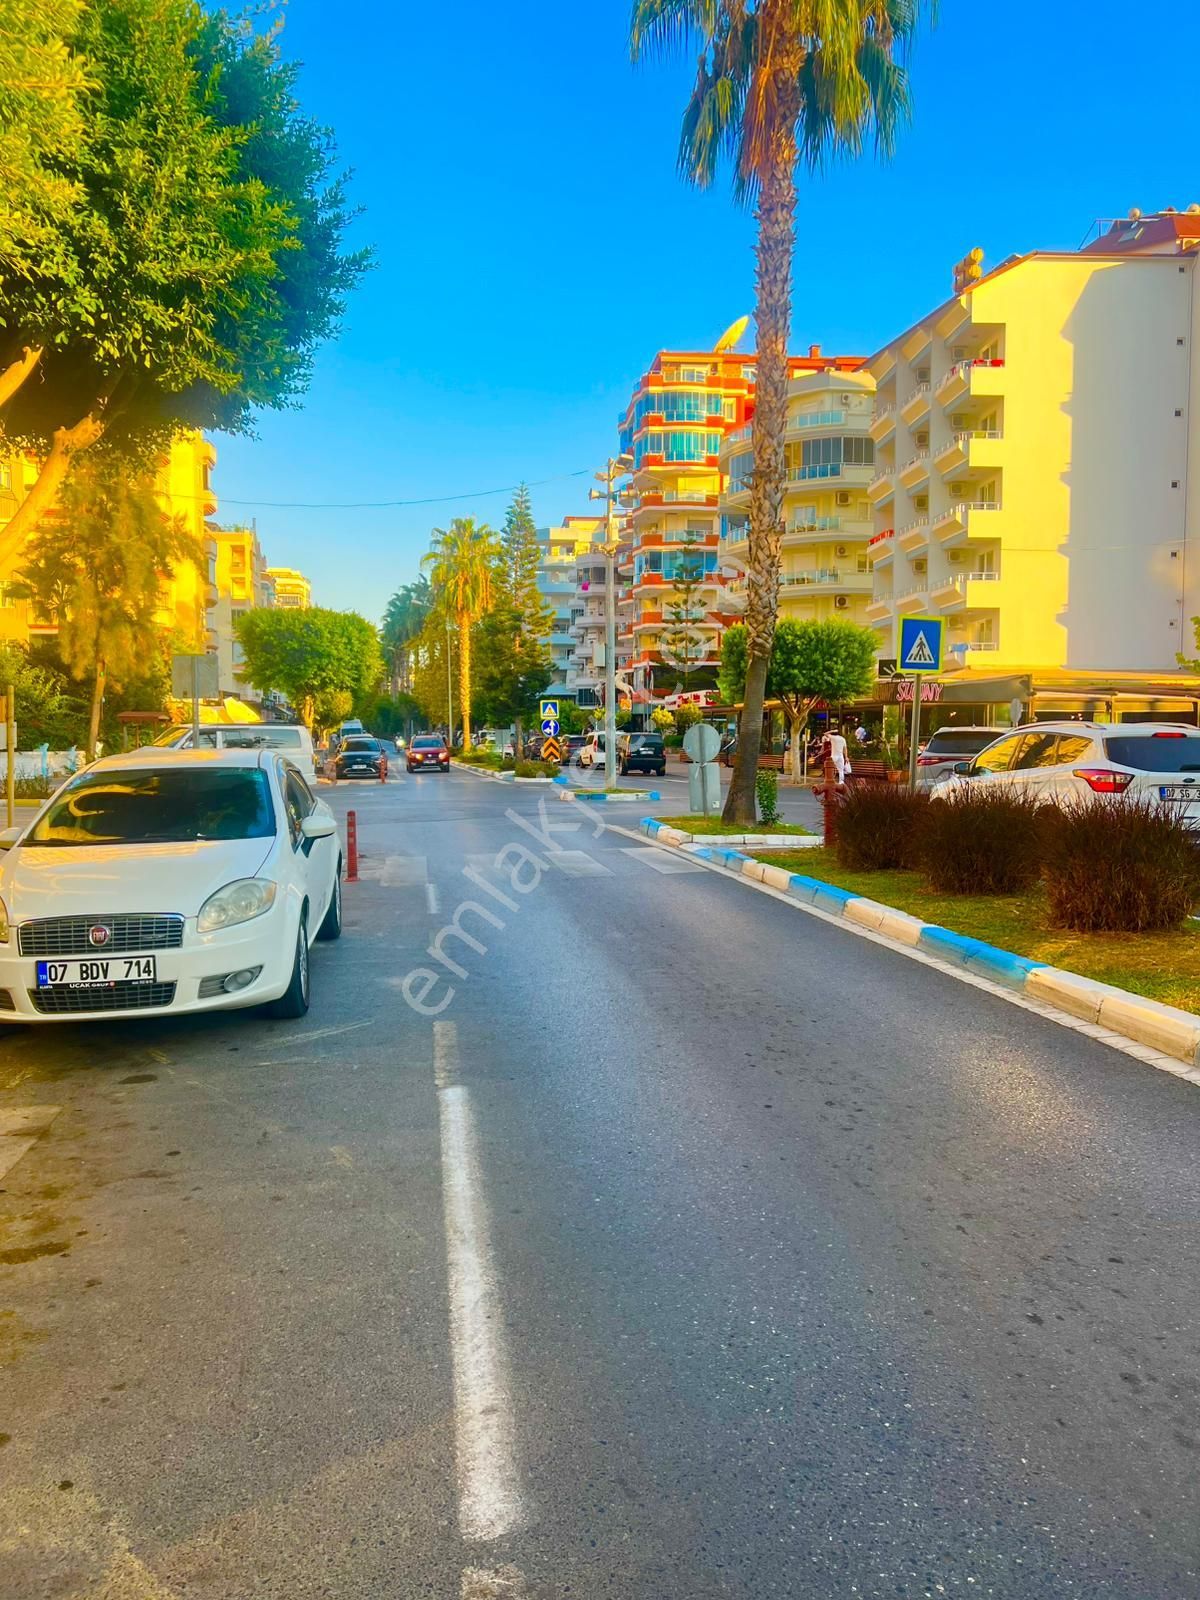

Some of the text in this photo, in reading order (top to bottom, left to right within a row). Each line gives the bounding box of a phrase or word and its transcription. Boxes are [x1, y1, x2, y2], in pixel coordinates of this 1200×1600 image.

[48, 959, 152, 982] 07 BDV 714
